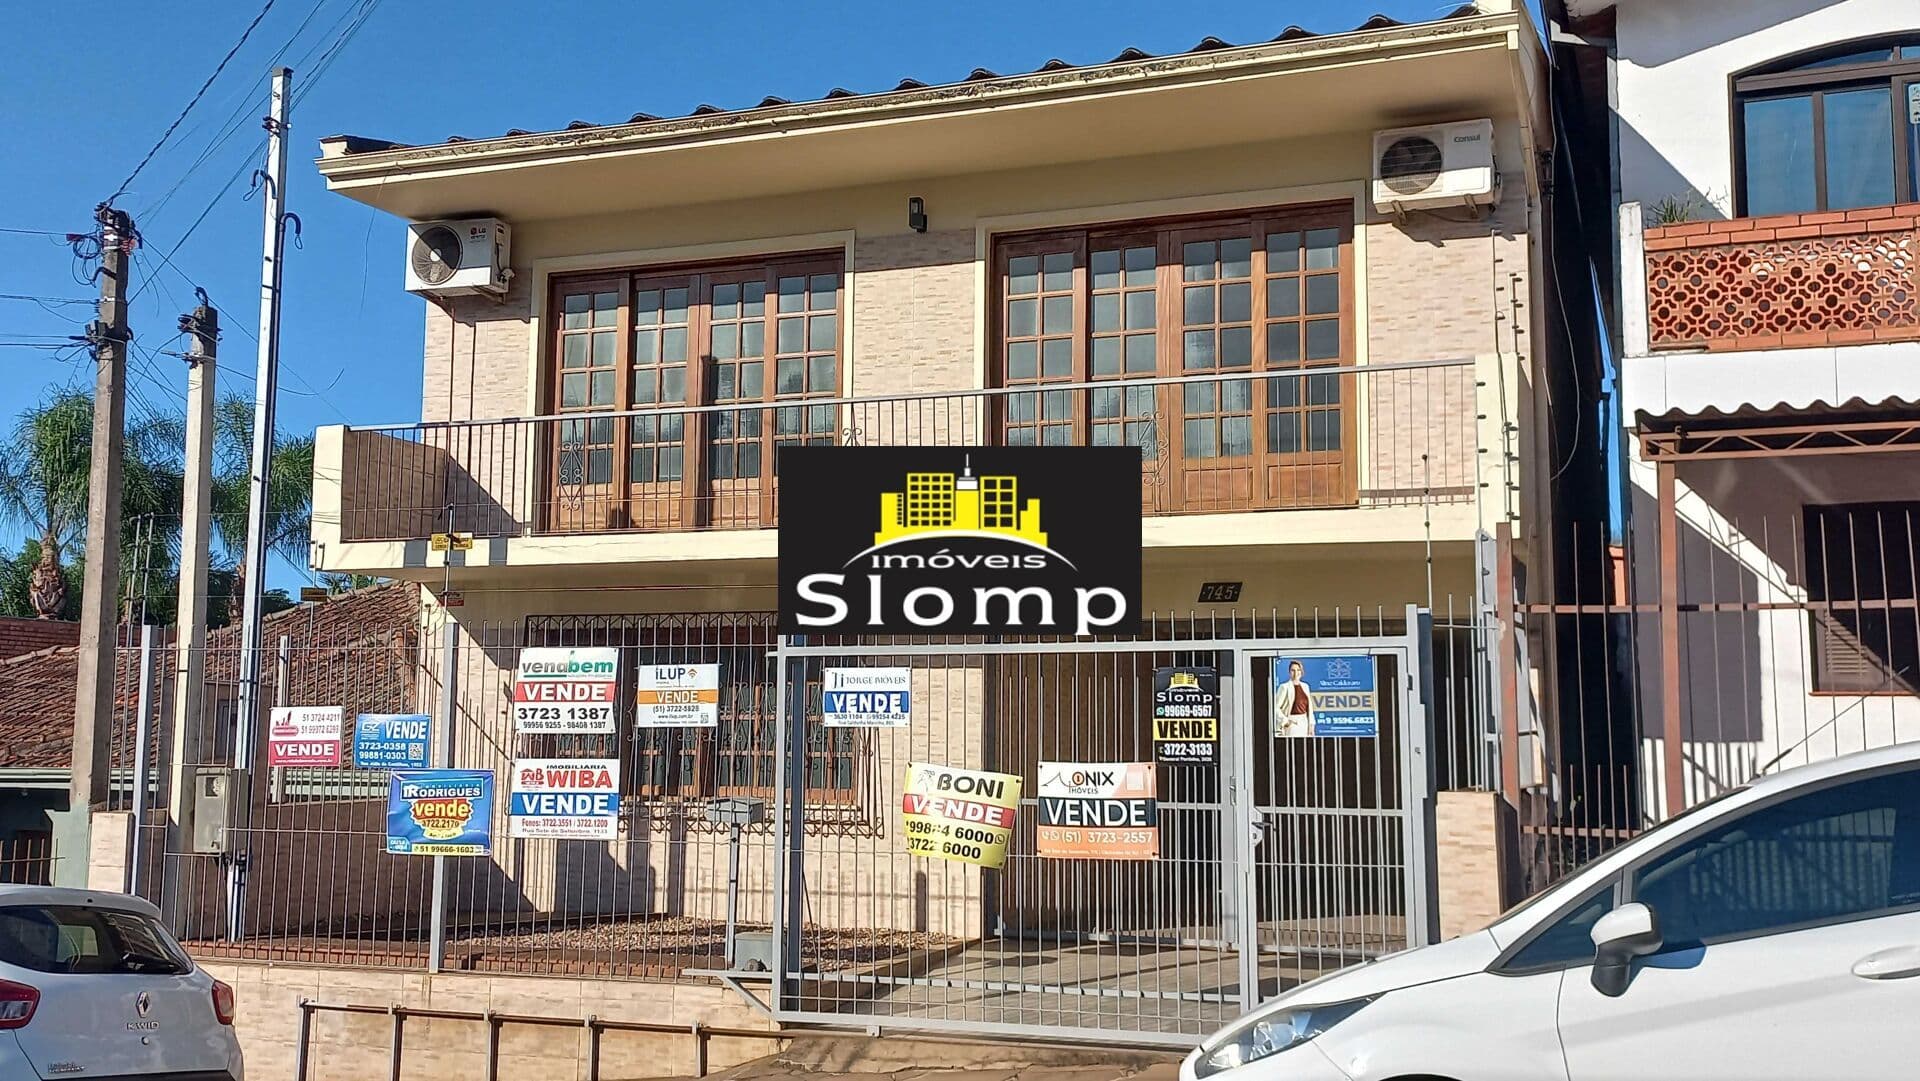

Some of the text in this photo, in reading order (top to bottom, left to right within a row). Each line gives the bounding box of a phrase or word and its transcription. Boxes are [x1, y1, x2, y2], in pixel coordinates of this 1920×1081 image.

[1207, 585, 1235, 600] 745
[655, 668, 686, 680] iLUP
[524, 683, 607, 701] VENDE
[656, 691, 699, 703] VENDE
[1156, 691, 1213, 704] Slomp
[832, 693, 901, 713] VENDE
[1312, 695, 1372, 708] VENDE
[518, 708, 610, 720] 3723 1387
[652, 705, 665, 714] (51)
[302, 713, 309, 722] 51
[590, 721, 606, 729] 1387
[385, 721, 428, 740] VENDE
[1157, 720, 1213, 739] VENDE
[275, 743, 335, 757] VENDE
[359, 742, 406, 750] 3723-0358
[1164, 743, 1213, 756] 3722-3133
[546, 770, 613, 788] WIBA
[1072, 770, 1114, 787] ONIX
[937, 773, 1005, 800] BONI
[414, 799, 469, 817] vende
[522, 794, 609, 815] VENDE
[911, 795, 1004, 826] VENDE
[1045, 799, 1147, 827] VENDE
[955, 827, 994, 845] 6000
[1061, 831, 1153, 844] (51) 3723-2557
[942, 842, 981, 859] 6000
[126, 1021, 160, 1031] KWID
